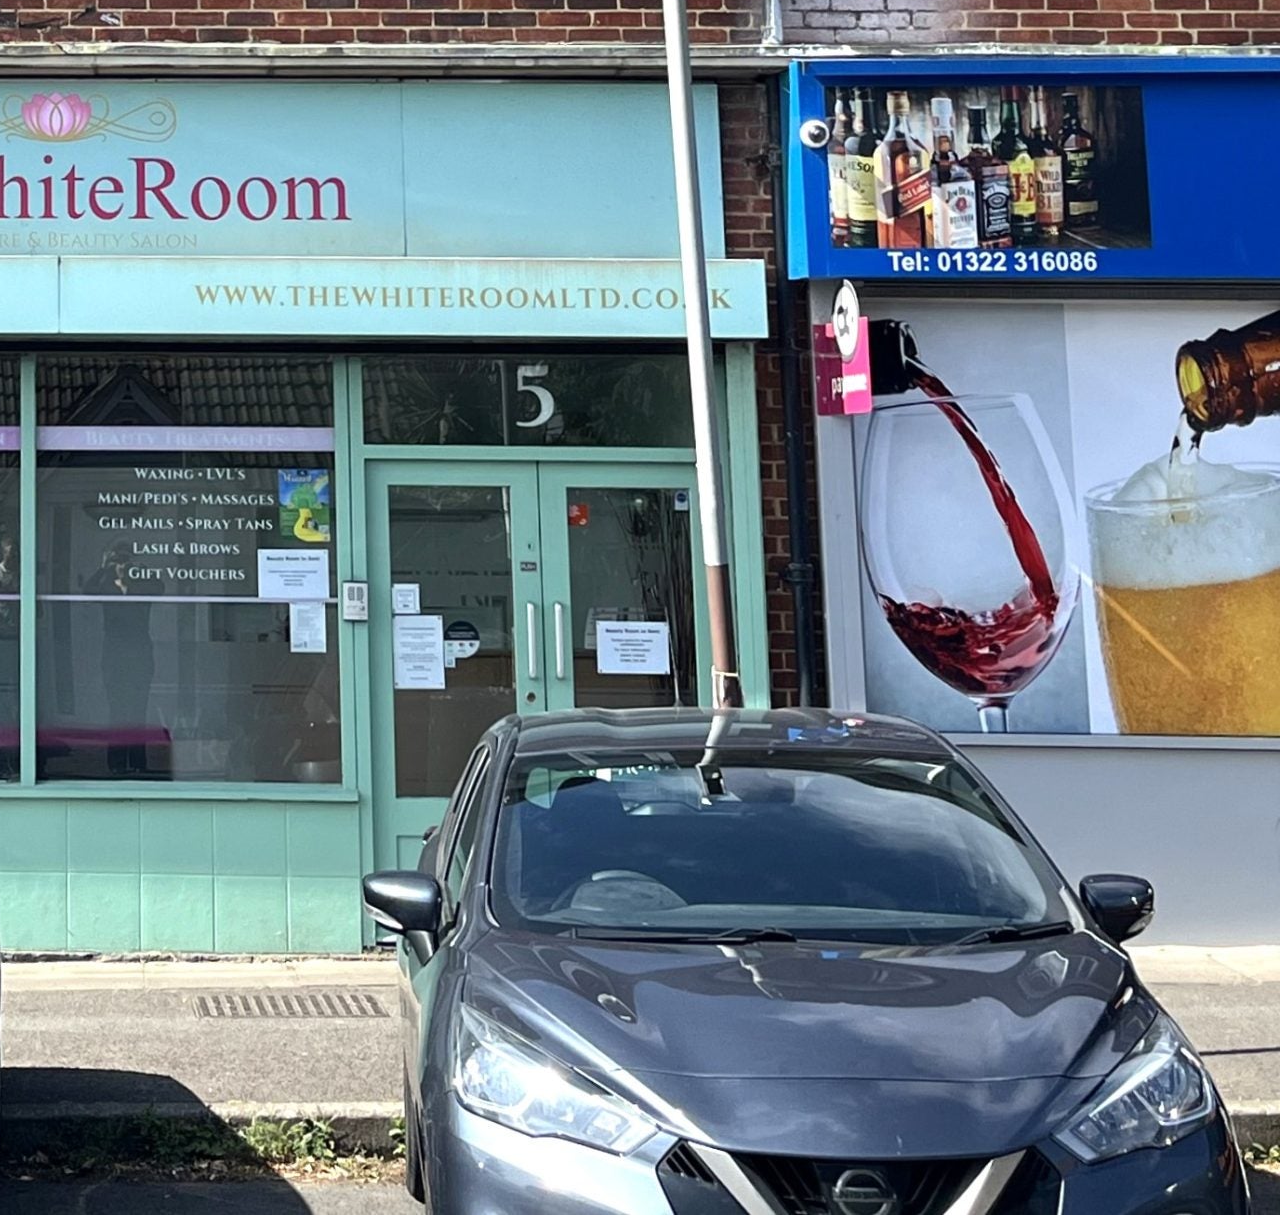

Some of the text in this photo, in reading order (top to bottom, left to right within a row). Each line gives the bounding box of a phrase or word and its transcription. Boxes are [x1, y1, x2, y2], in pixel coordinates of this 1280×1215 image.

[48, 232, 127, 248] BEAUTY
[130, 233, 198, 248] SALON
[887, 251, 1098, 272] Tel: 01322 316086
[195, 284, 733, 310] WWW.THEWHITEROOMLTD.CO.K
[516, 364, 555, 428] 5
[134, 468, 194, 480] WAXING
[200, 493, 275, 505] MASSAGES
[98, 517, 274, 531] GEL NAILS SPRAY TANS
[132, 542, 240, 555] LASH & BROWS
[128, 567, 245, 581] GIFT VOUCHERS
